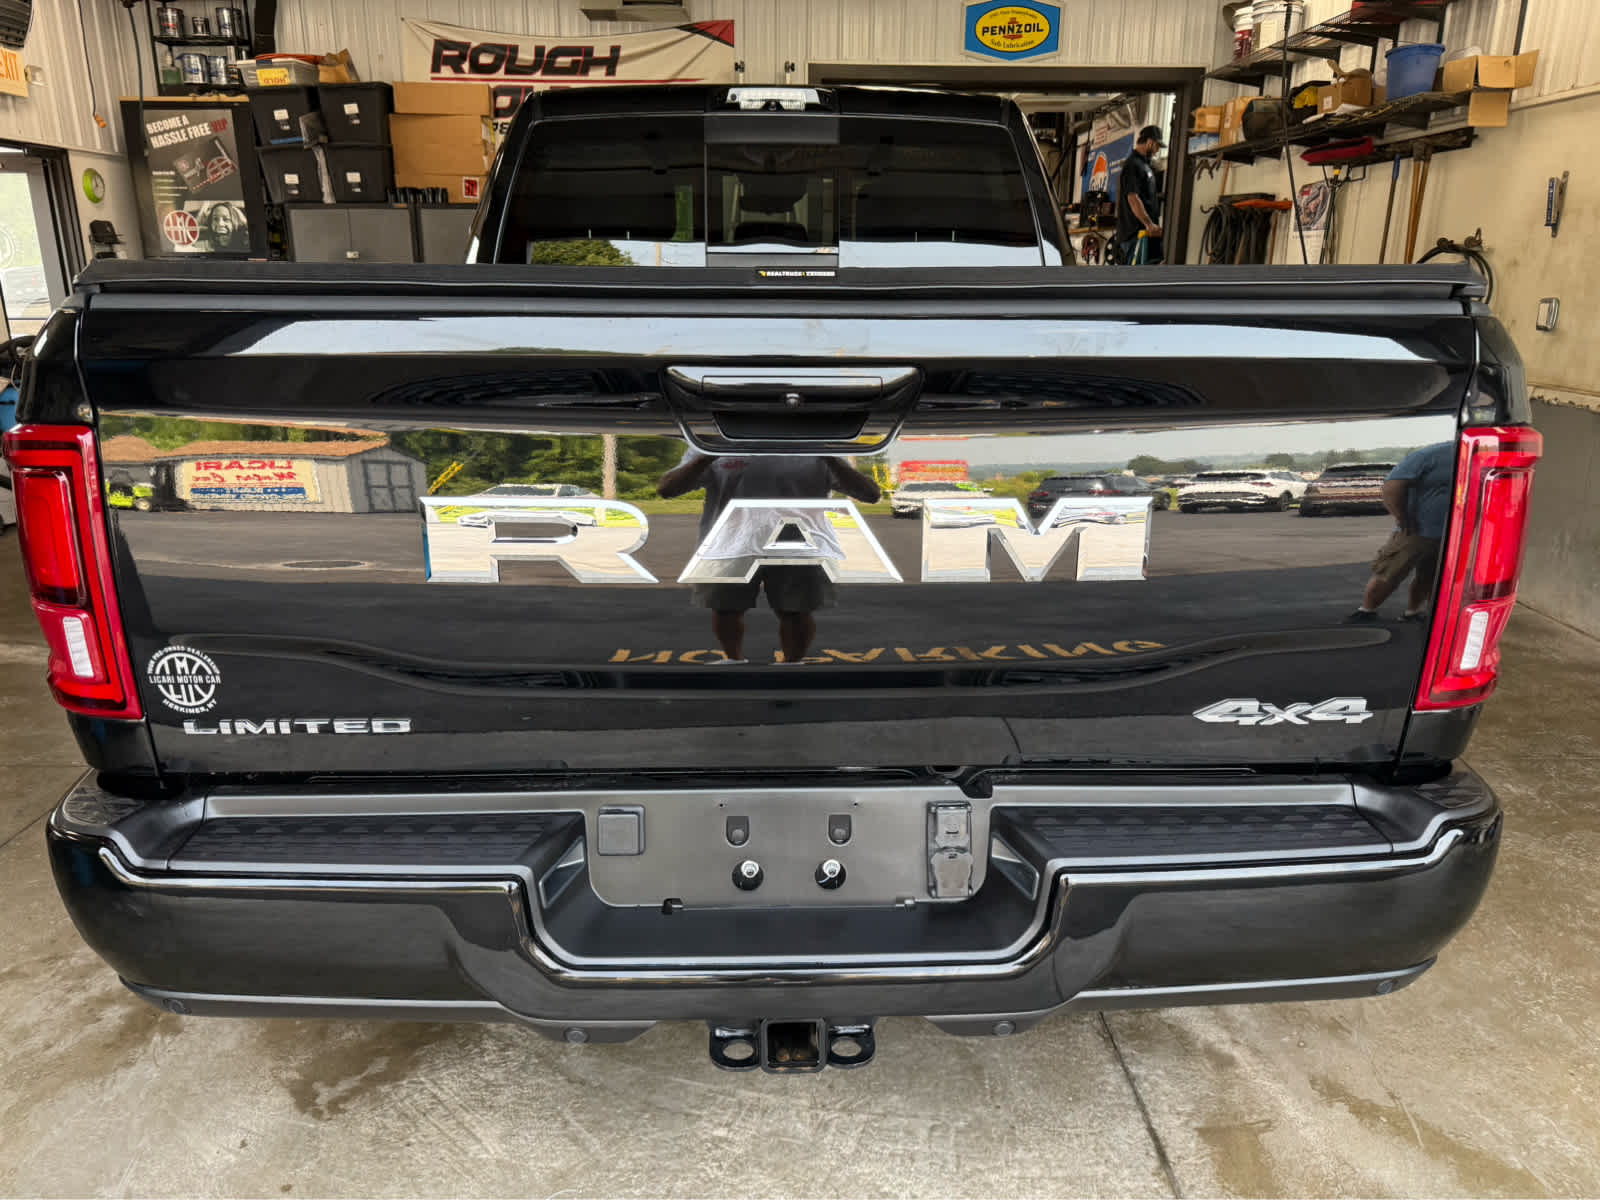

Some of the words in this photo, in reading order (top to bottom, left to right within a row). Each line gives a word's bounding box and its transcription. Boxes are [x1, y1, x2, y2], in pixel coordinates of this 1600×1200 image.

[982, 22, 1044, 37] PENNZOIL
[430, 39, 621, 77] ROUGH
[146, 116, 183, 134] BECOME
[181, 114, 190, 126] A
[150, 128, 188, 149] HASSLE
[187, 122, 212, 139] FREE
[210, 117, 228, 132] VIP
[419, 496, 1154, 584] RAM
[148, 675, 175, 684] LICARI
[176, 675, 204, 684] MOTOR
[205, 675, 221, 684] CAR
[1192, 696, 1374, 726] 4x4
[183, 718, 411, 735] LIMITED
